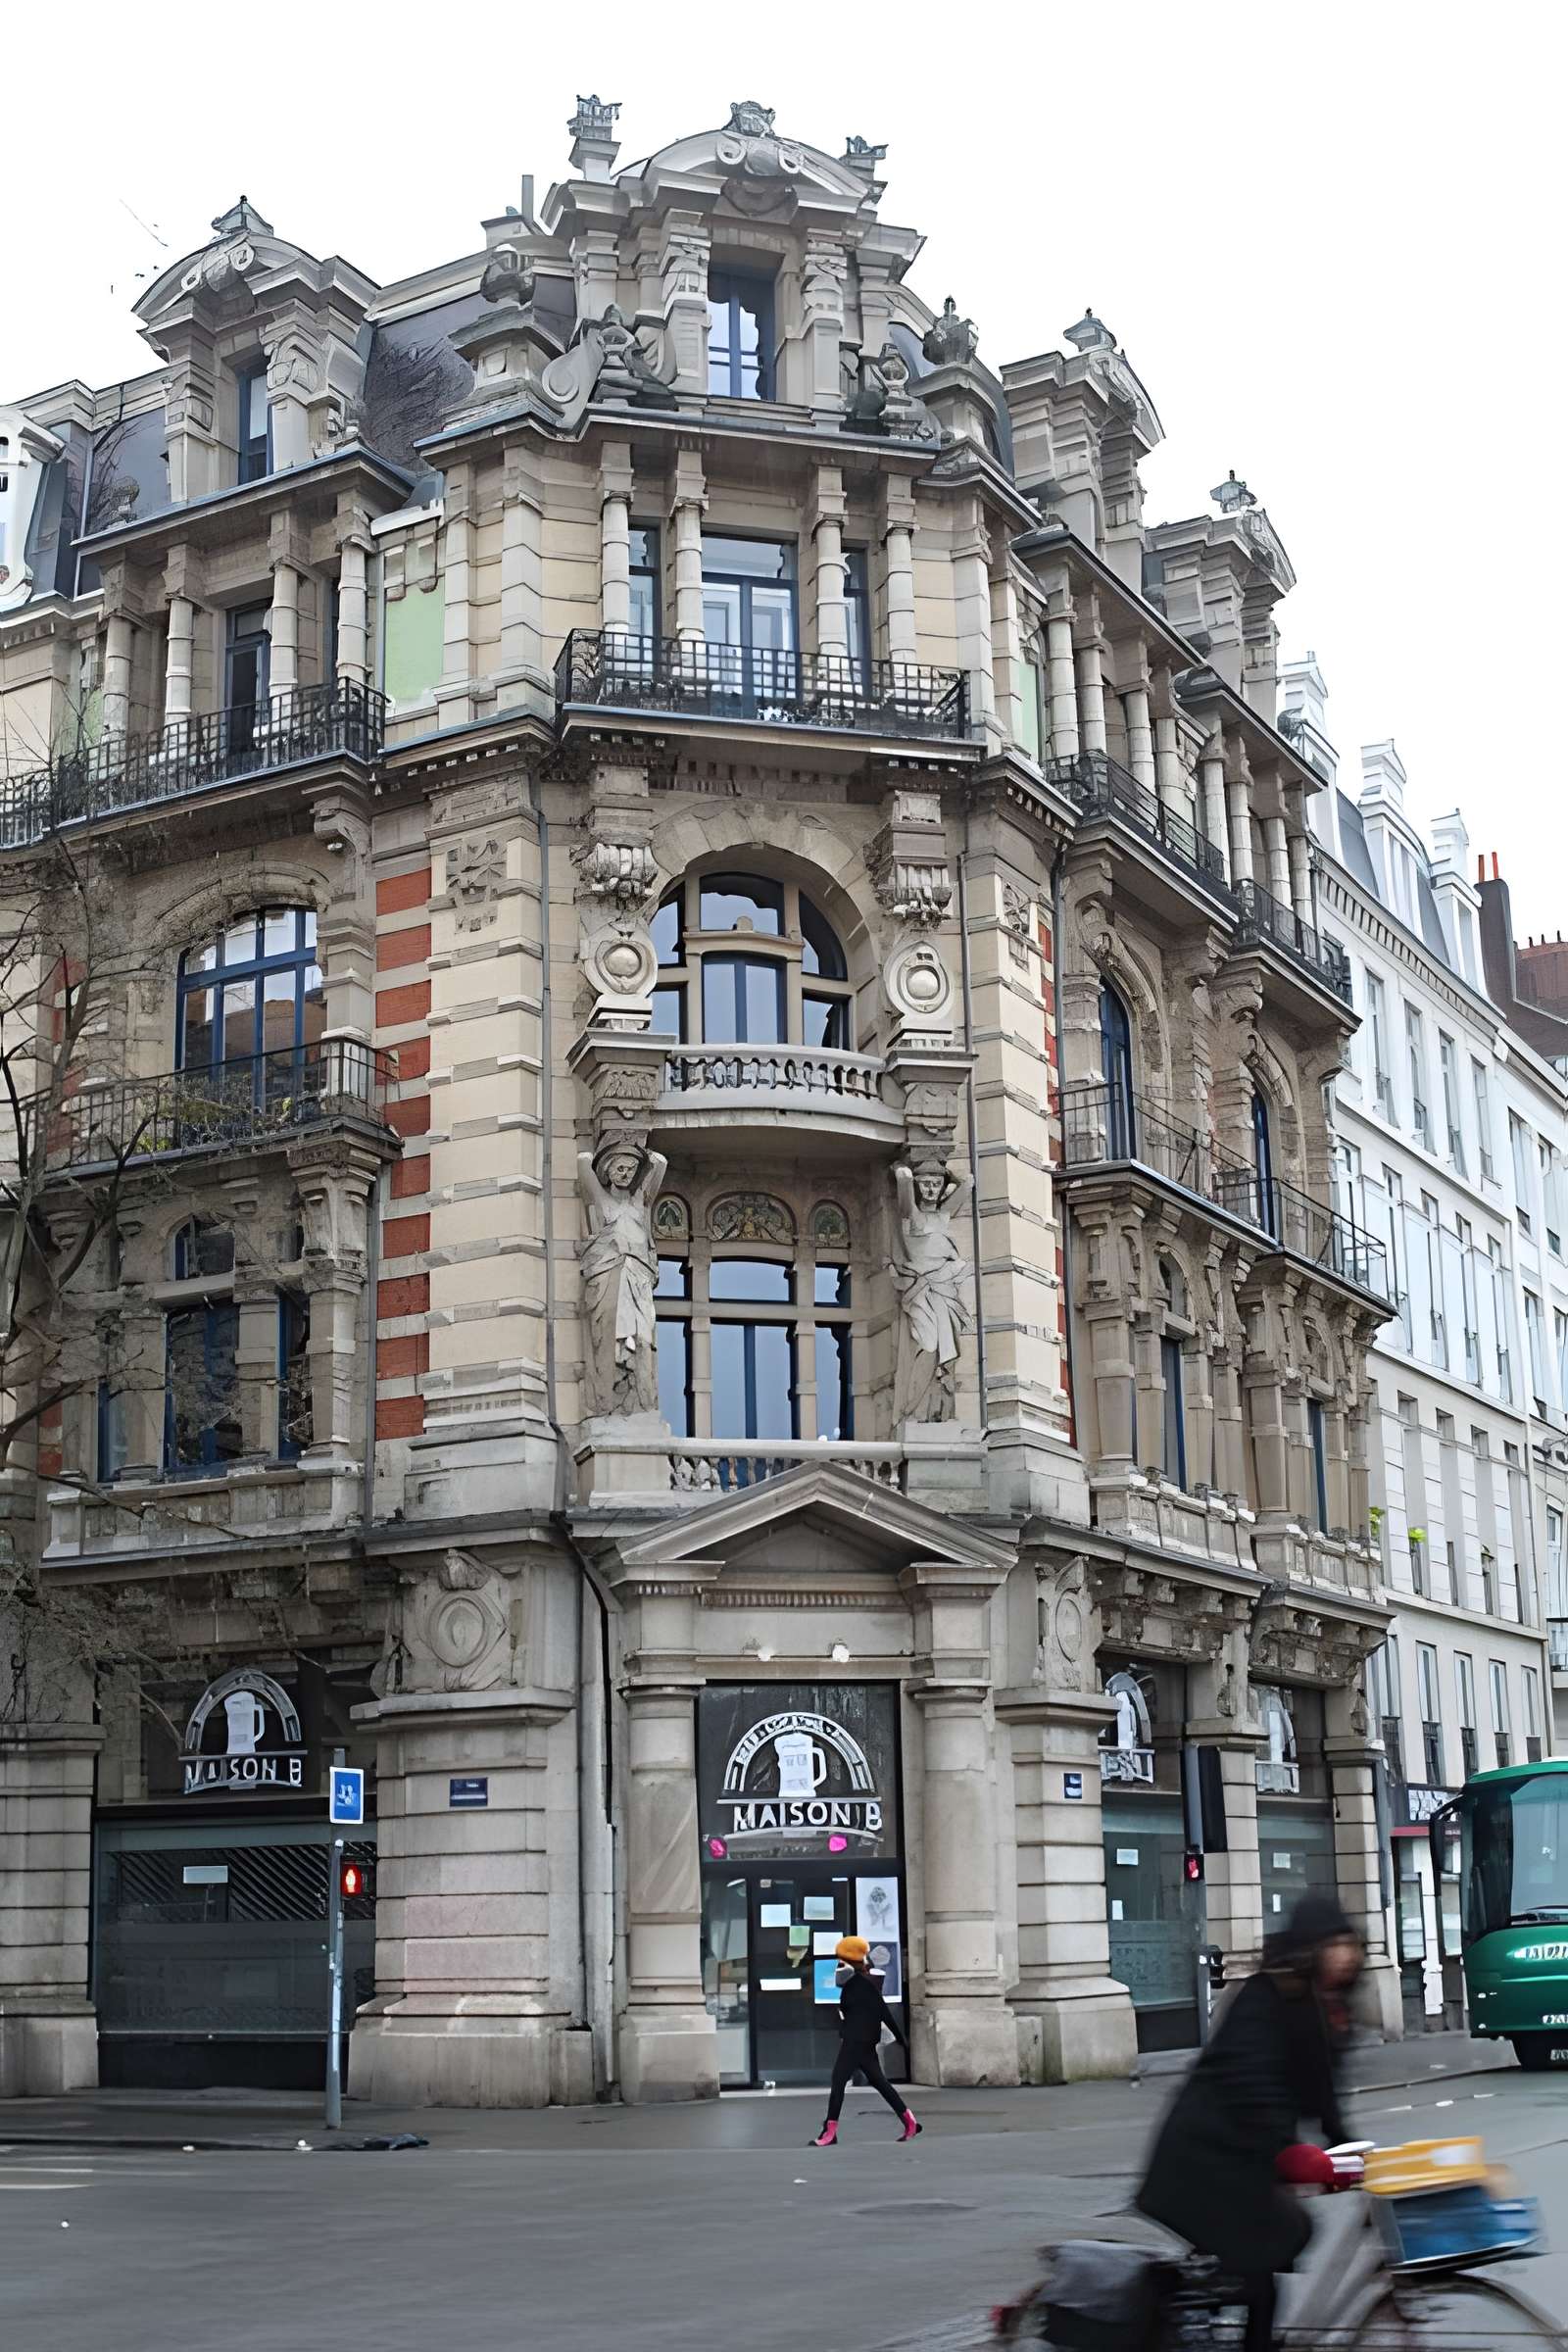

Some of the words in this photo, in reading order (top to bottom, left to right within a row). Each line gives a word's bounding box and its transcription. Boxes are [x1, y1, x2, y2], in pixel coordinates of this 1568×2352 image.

[289, 1757, 302, 1785] B
[734, 1801, 851, 1831] MAISON
[865, 1801, 882, 1831] B
